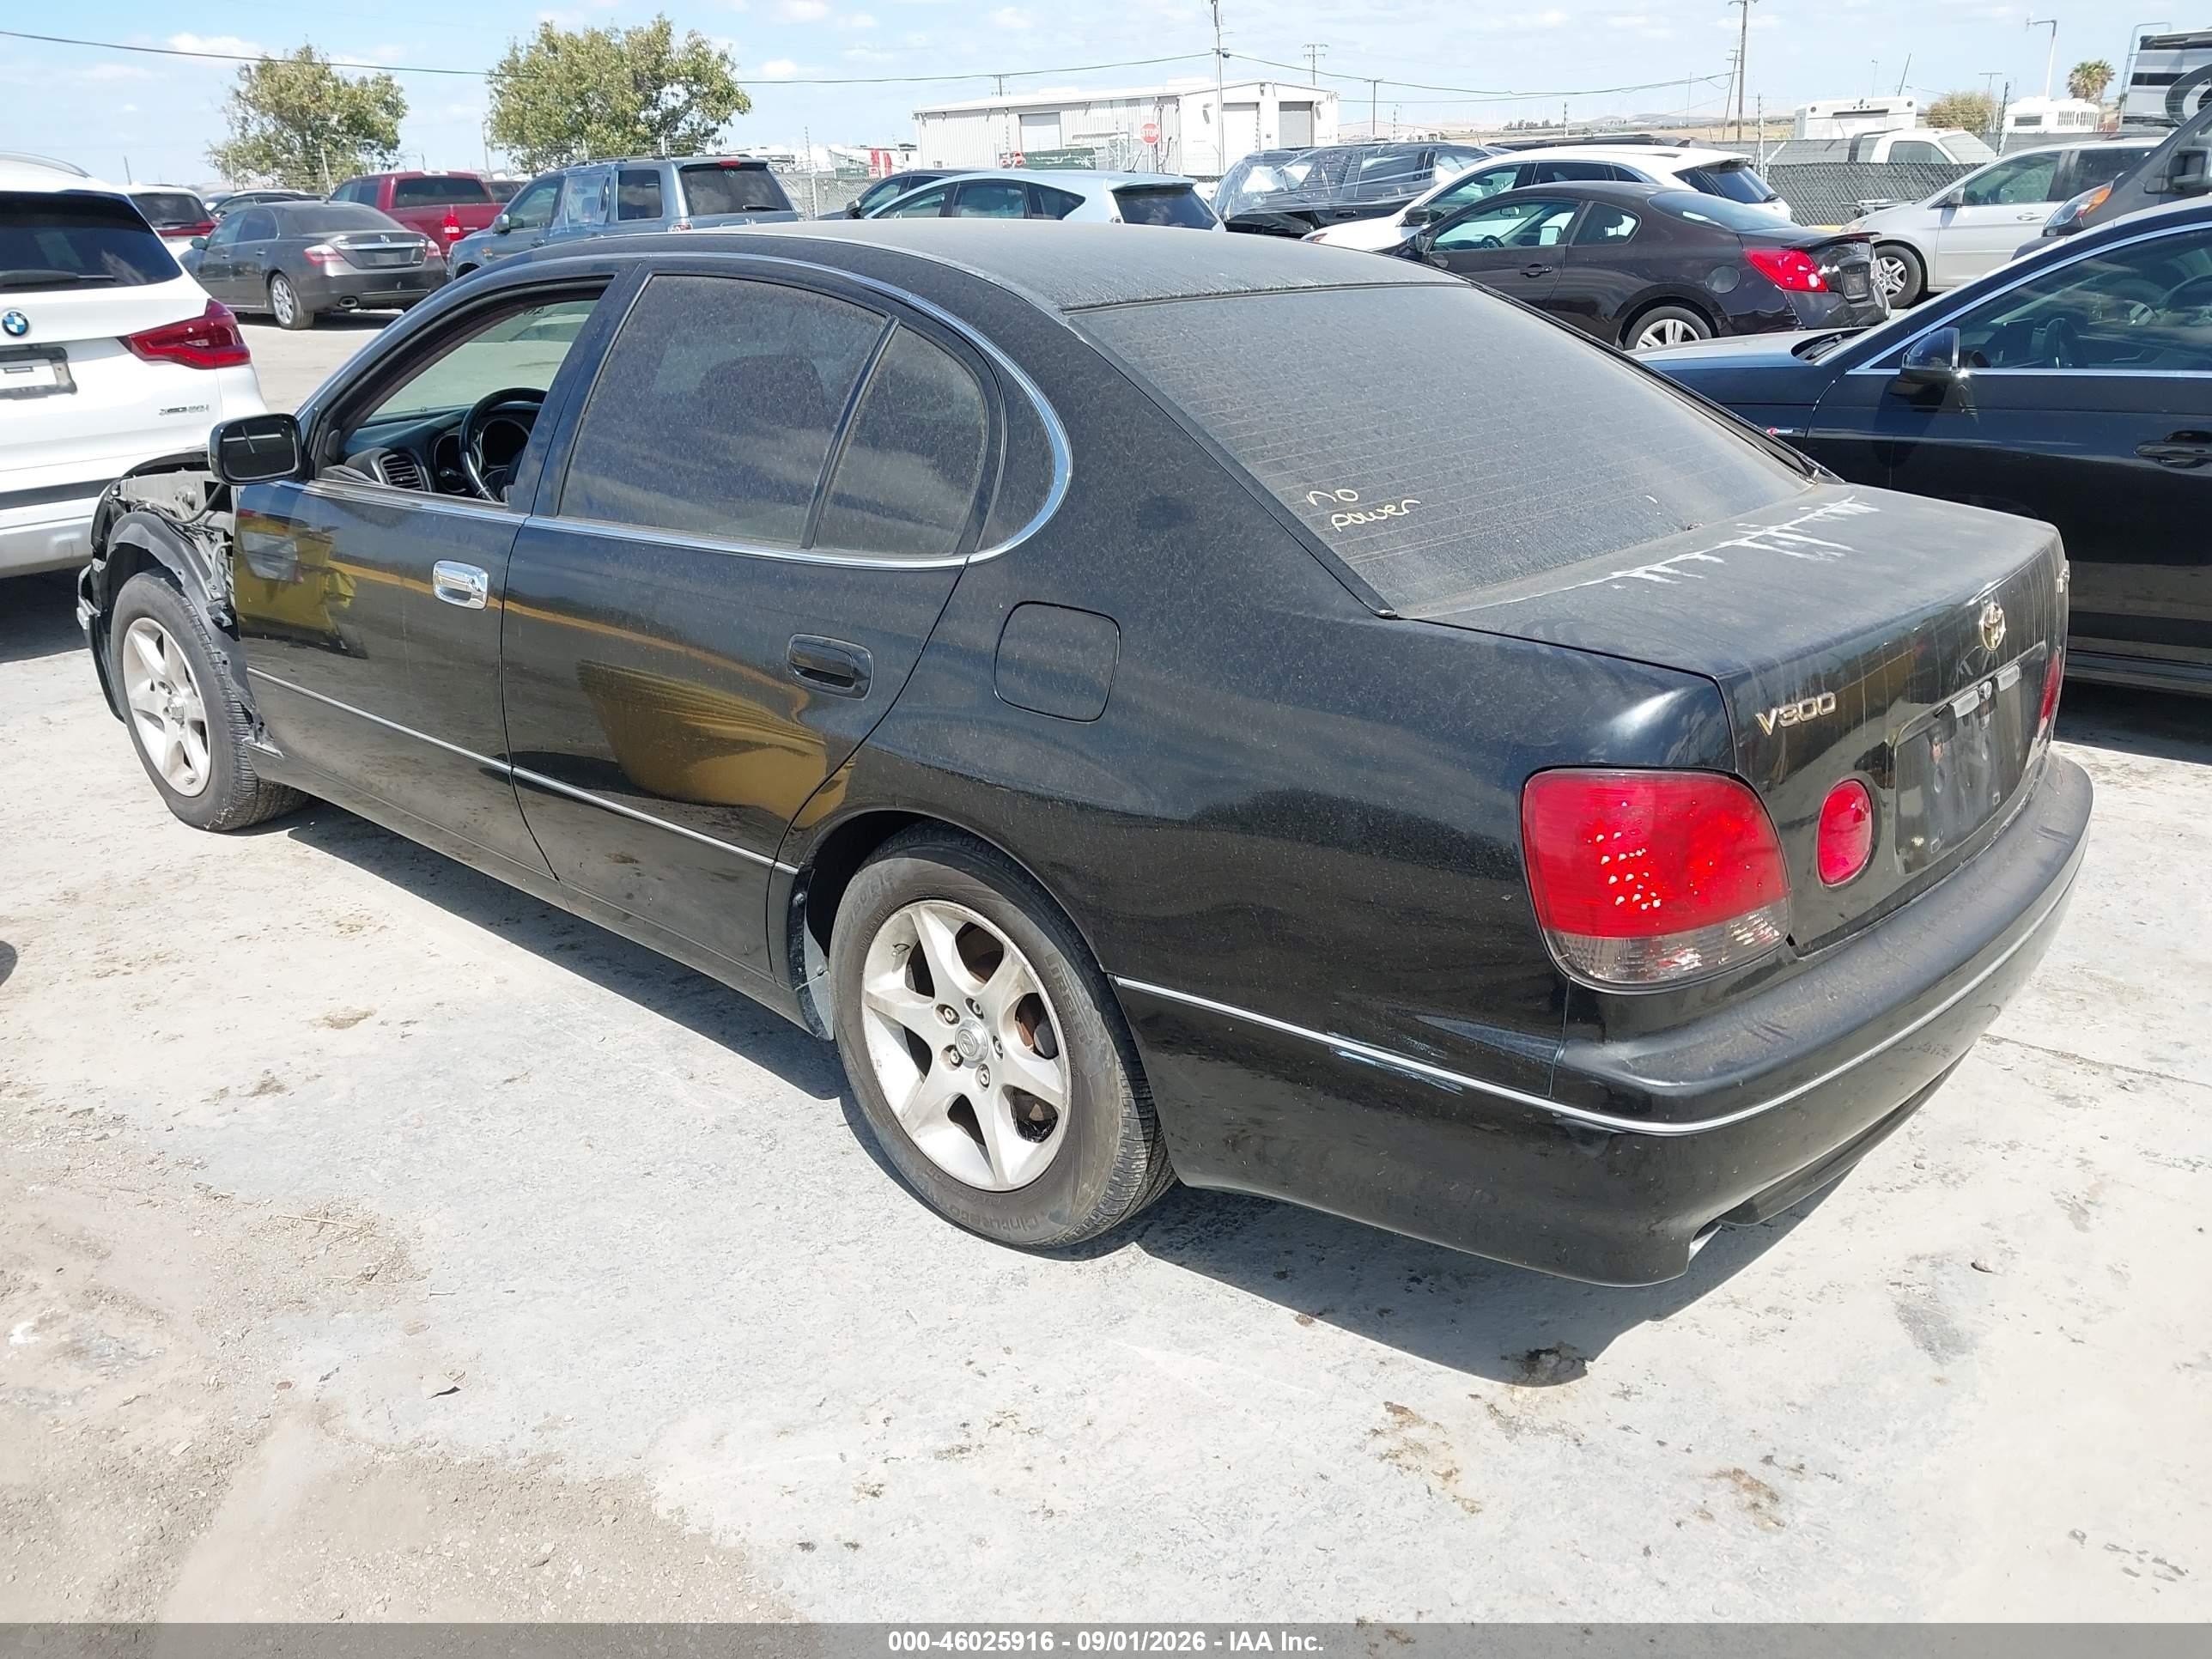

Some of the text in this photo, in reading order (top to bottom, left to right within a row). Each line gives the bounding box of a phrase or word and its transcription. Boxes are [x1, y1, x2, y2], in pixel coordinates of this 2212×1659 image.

[1140, 129, 1159, 137] STOP
[1306, 489, 1359, 507] no
[1331, 500, 1422, 532] power
[1754, 691, 1838, 736] V300
